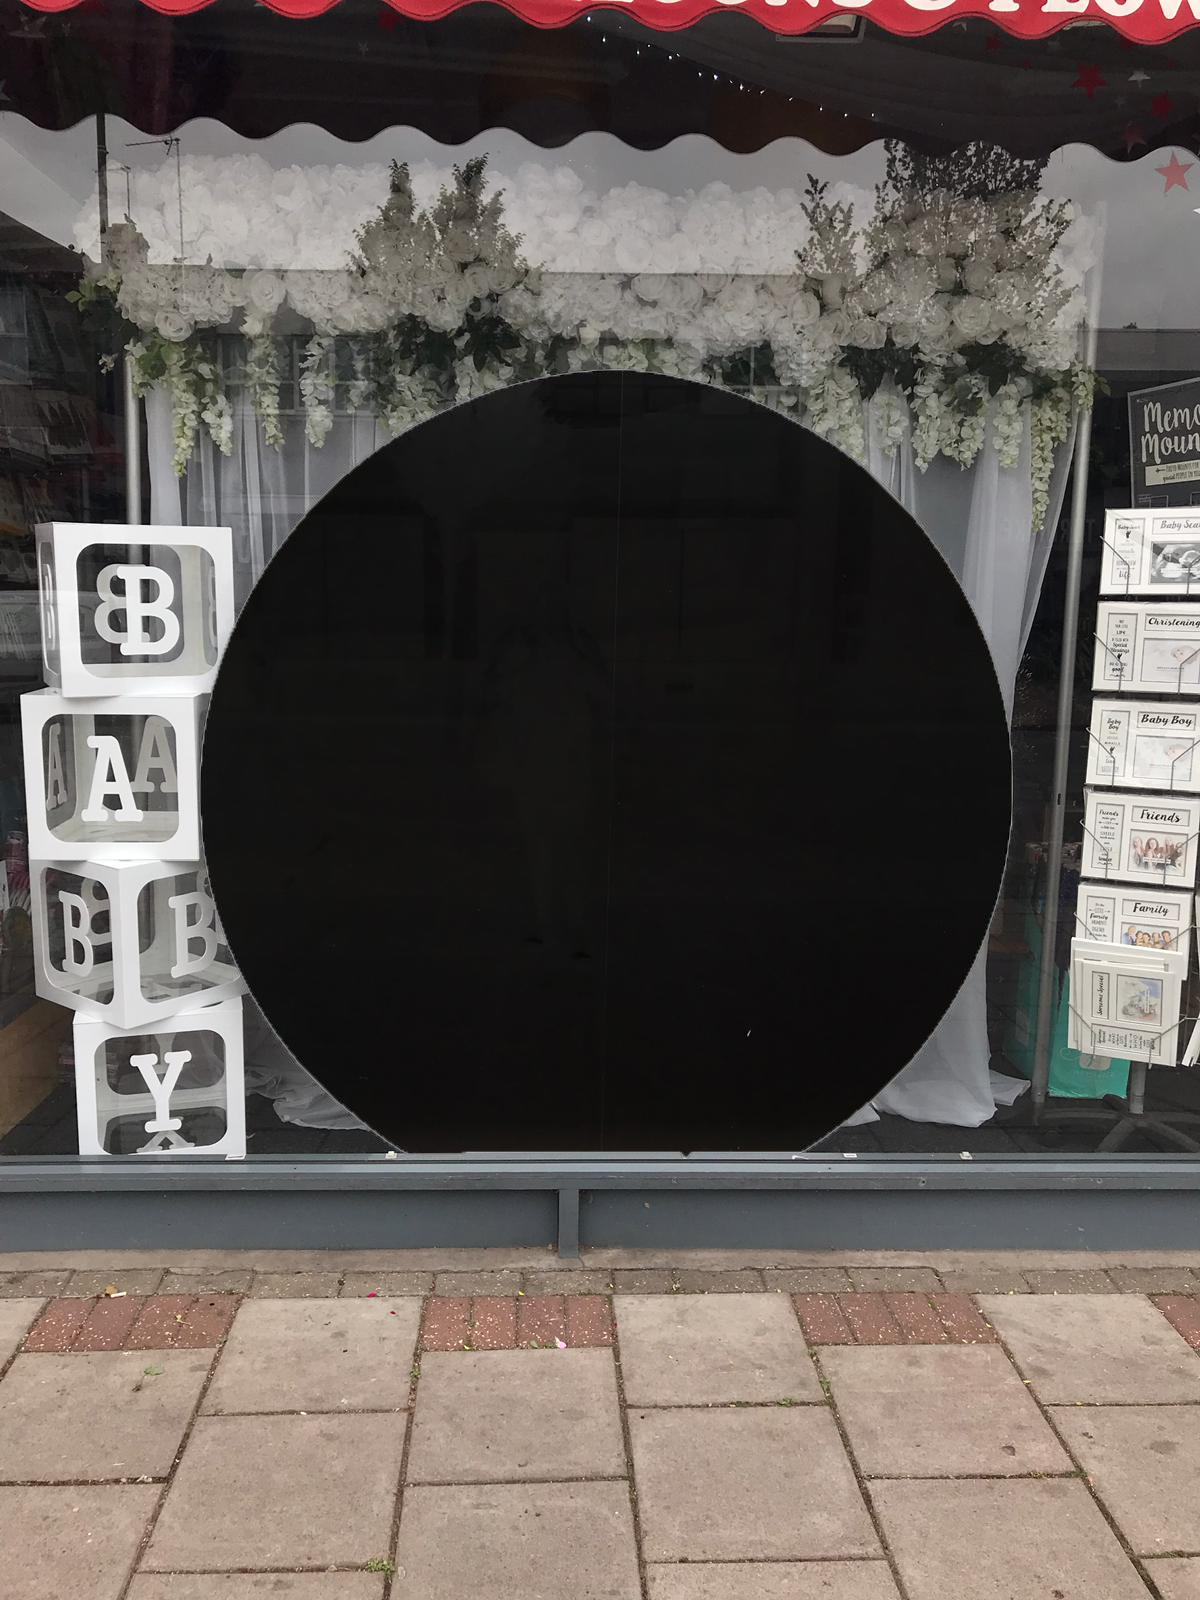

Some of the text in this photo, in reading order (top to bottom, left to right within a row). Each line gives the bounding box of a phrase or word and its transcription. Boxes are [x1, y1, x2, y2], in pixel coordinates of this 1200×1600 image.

[1160, 519, 1200, 531] Baby Sca
[116, 565, 180, 656] B
[1148, 617, 1200, 629] Christening
[1140, 713, 1193, 728] Baby Boy
[81, 735, 144, 822] A
[1140, 808, 1181, 823] Friends
[58, 890, 94, 978] B
[1132, 902, 1169, 917] Family
[168, 891, 218, 979] B
[130, 1050, 192, 1133] Y
